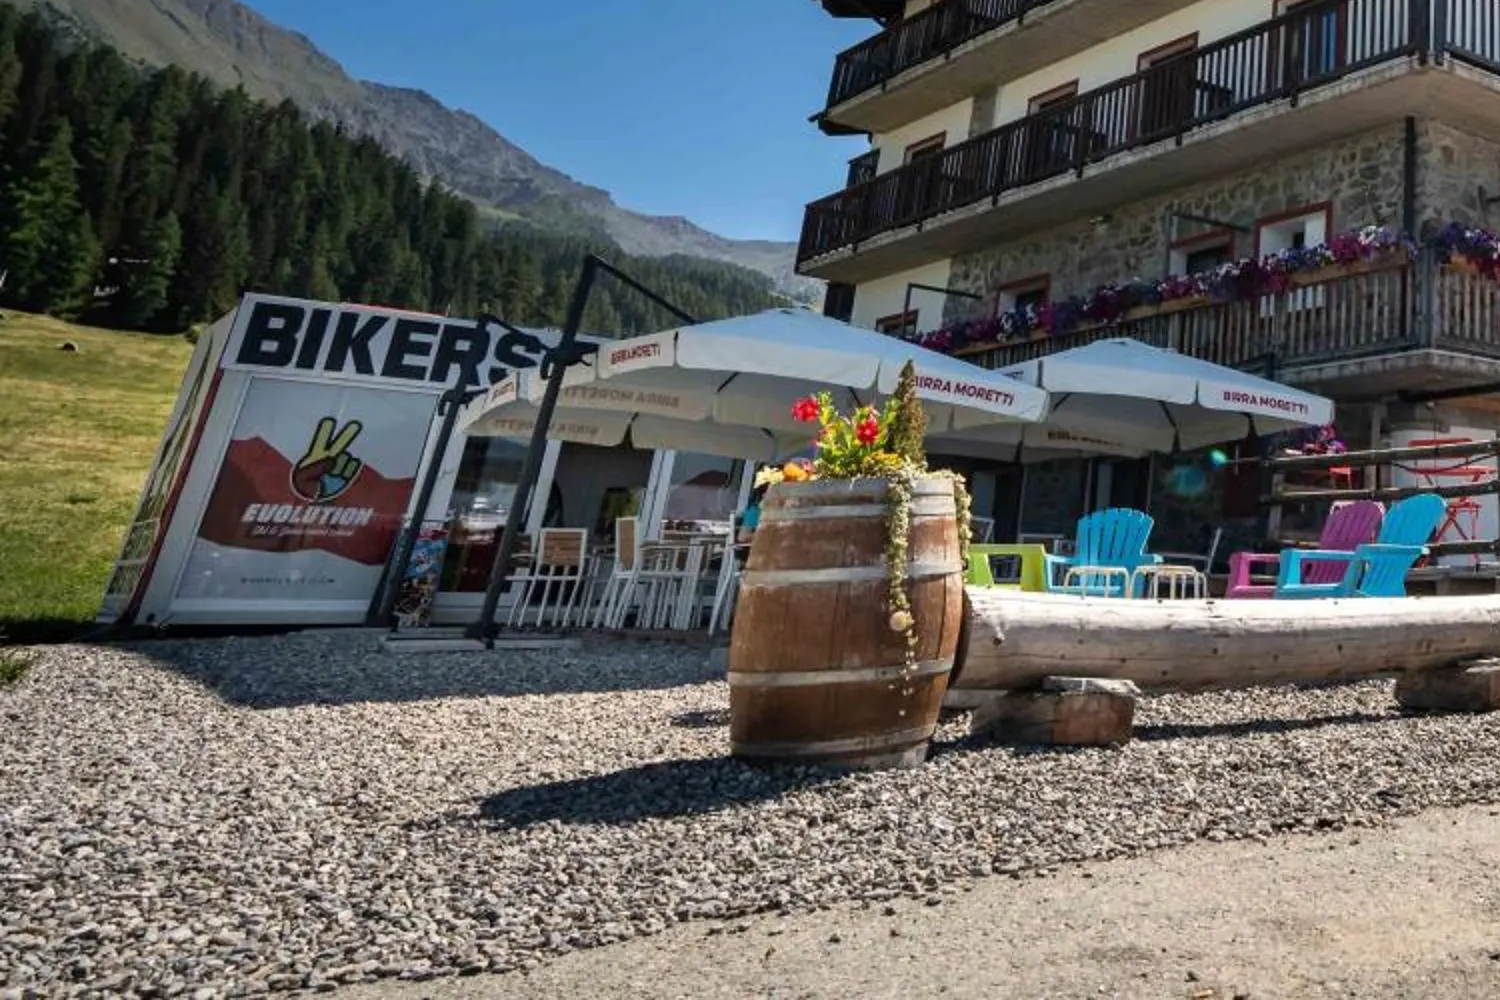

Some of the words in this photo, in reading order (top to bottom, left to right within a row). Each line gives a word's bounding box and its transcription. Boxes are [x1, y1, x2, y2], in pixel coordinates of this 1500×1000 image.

[236, 302, 542, 386] BIKERS
[953, 381, 1015, 407] MORETTI
[241, 503, 375, 526] EVOLUTION
